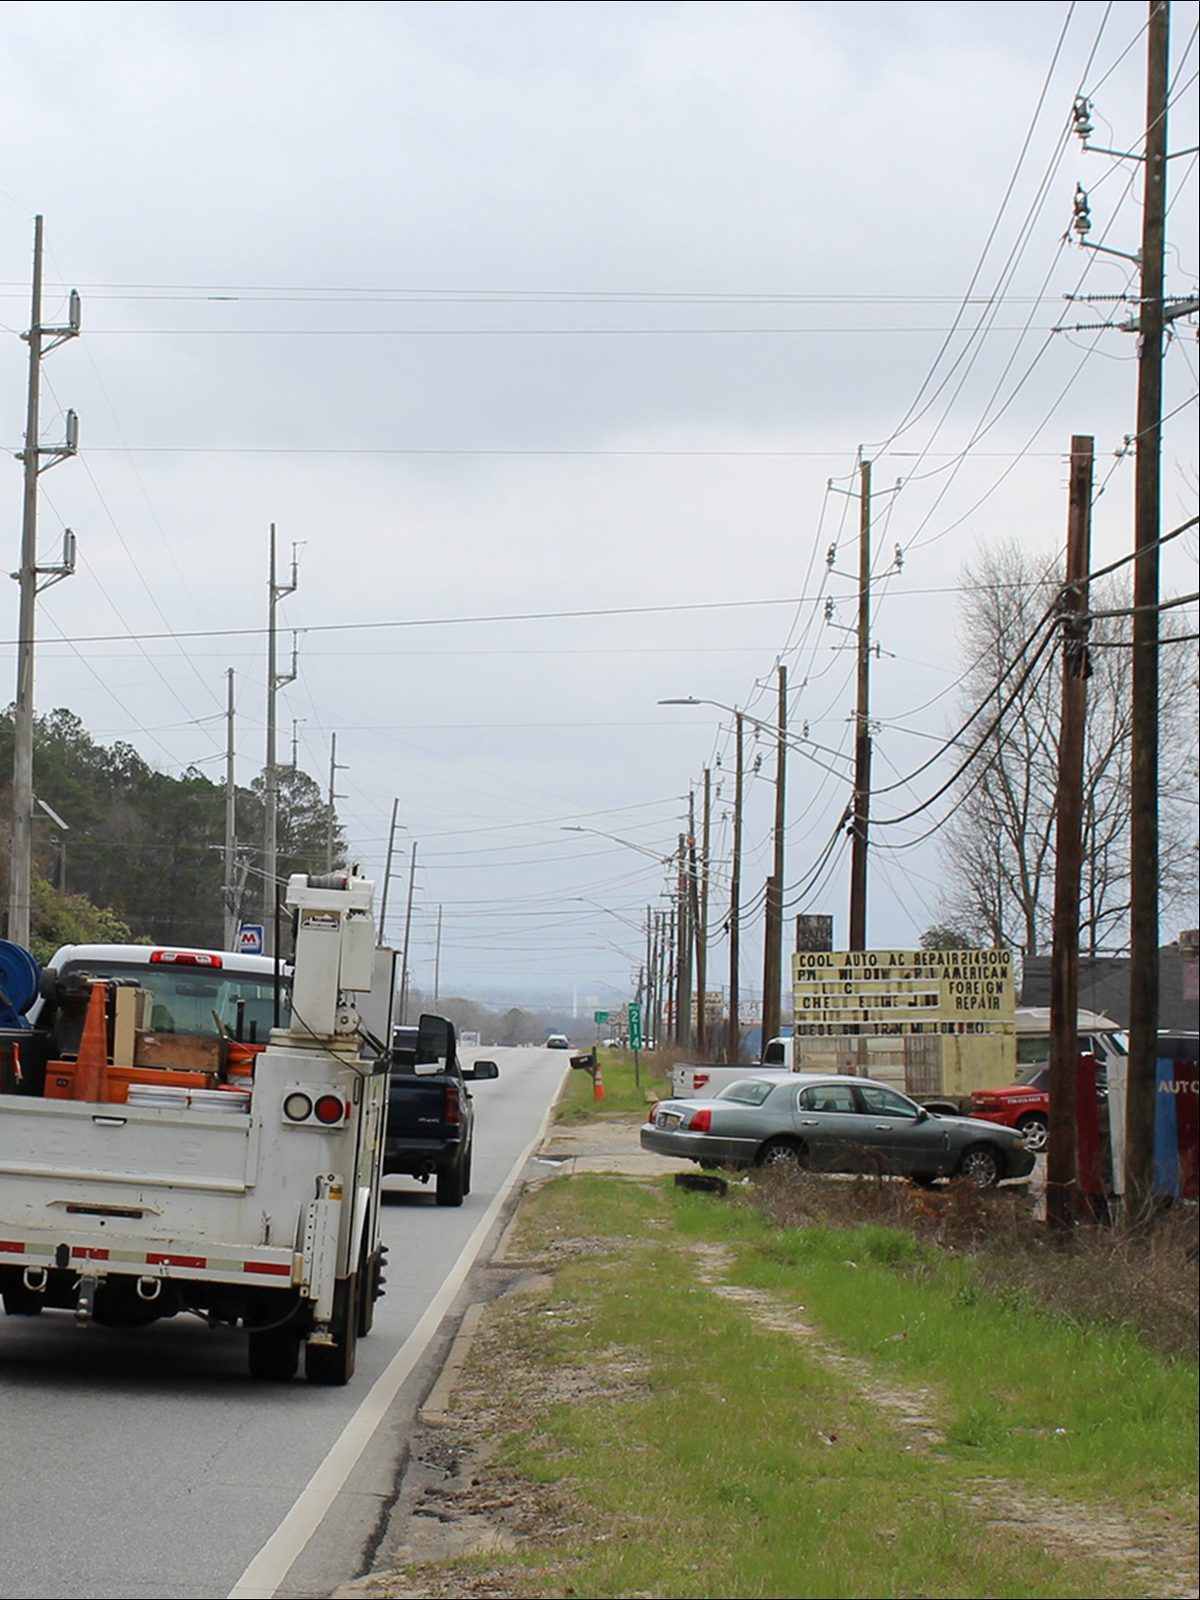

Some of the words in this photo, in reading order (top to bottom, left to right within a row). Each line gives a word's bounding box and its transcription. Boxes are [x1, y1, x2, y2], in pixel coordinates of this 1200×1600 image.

[799, 954, 834, 968] COOL
[844, 953, 878, 967] AUTO
[888, 953, 905, 967] AC
[914, 952, 959, 966] REPAIR
[942, 966, 1008, 980] AMERICAN
[948, 980, 1004, 995] FOREIGN
[955, 995, 1001, 1010] REPAIR
[631, 1010, 640, 1048] 214
